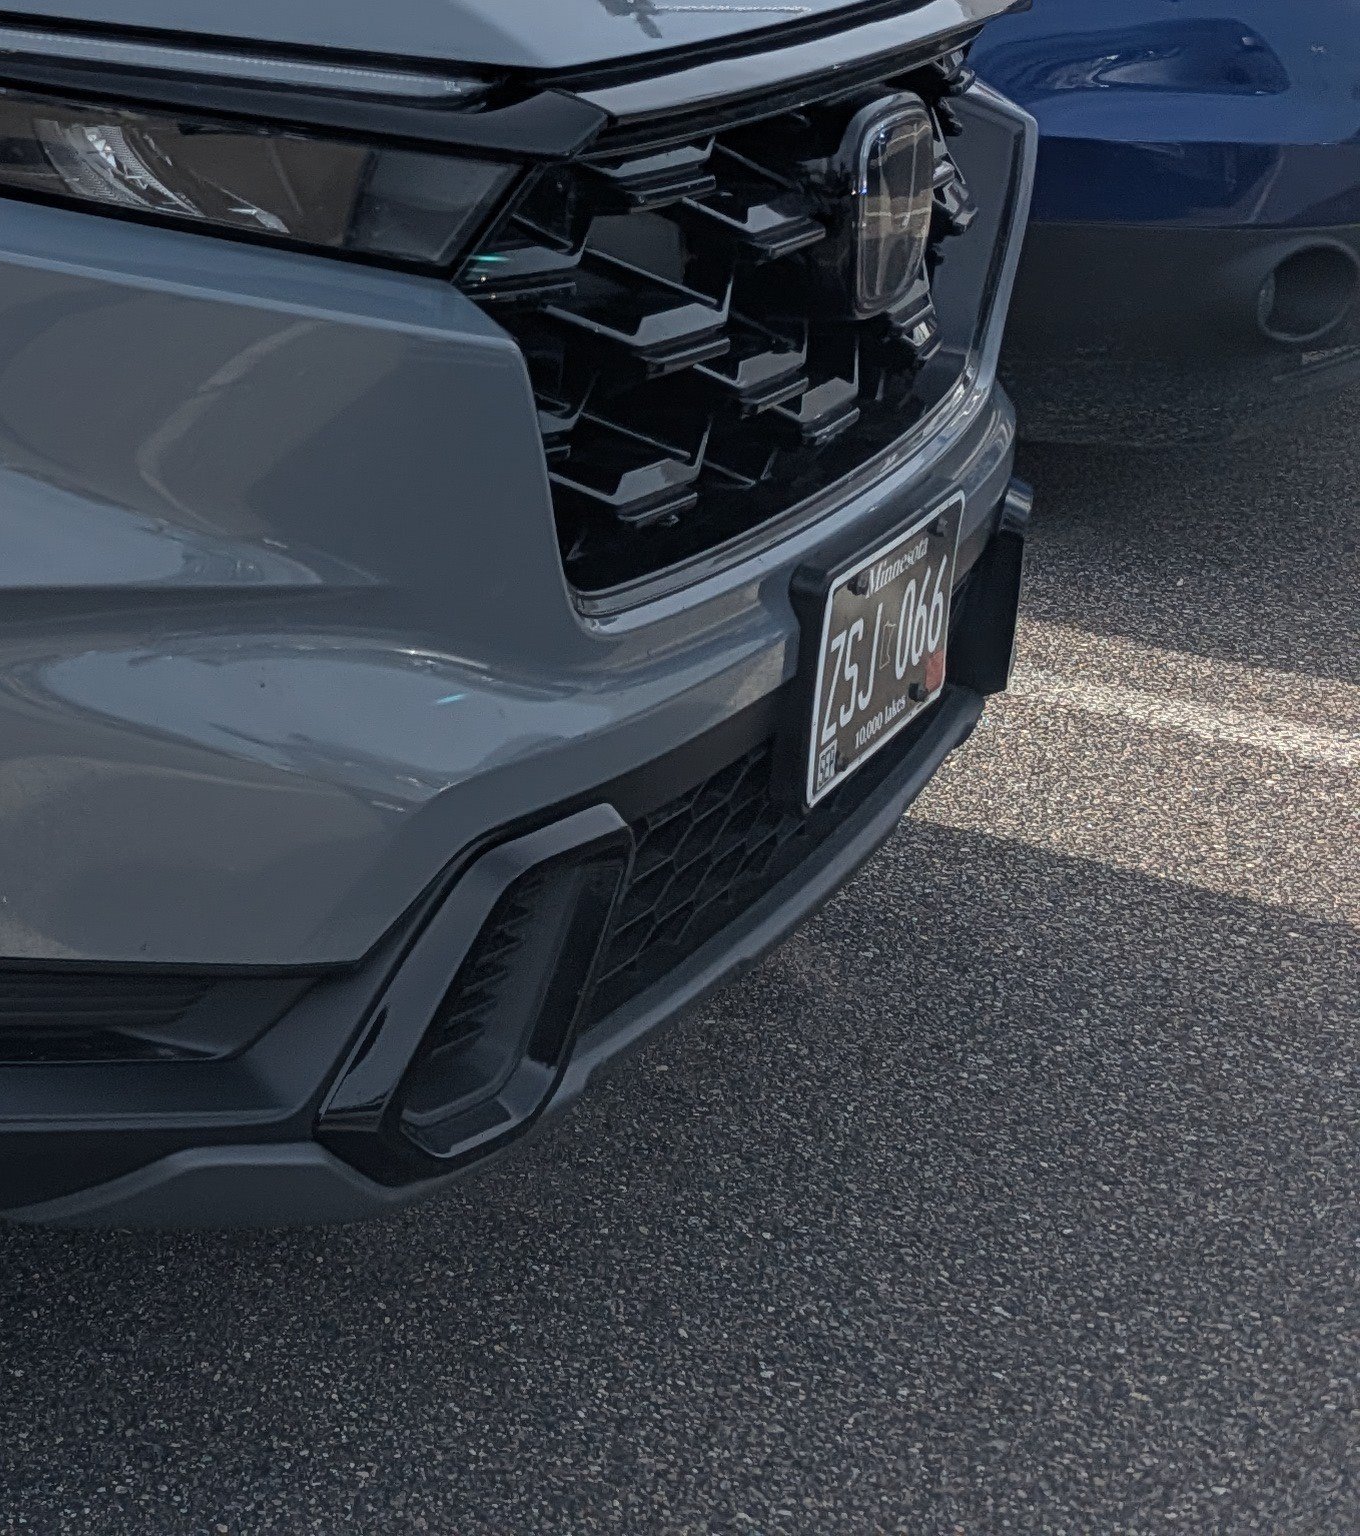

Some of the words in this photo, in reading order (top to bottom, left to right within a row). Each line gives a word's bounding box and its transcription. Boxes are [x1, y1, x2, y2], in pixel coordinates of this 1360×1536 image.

[865, 536, 930, 600] Minnesota
[821, 602, 884, 746] ZSJ
[894, 554, 948, 680] 066
